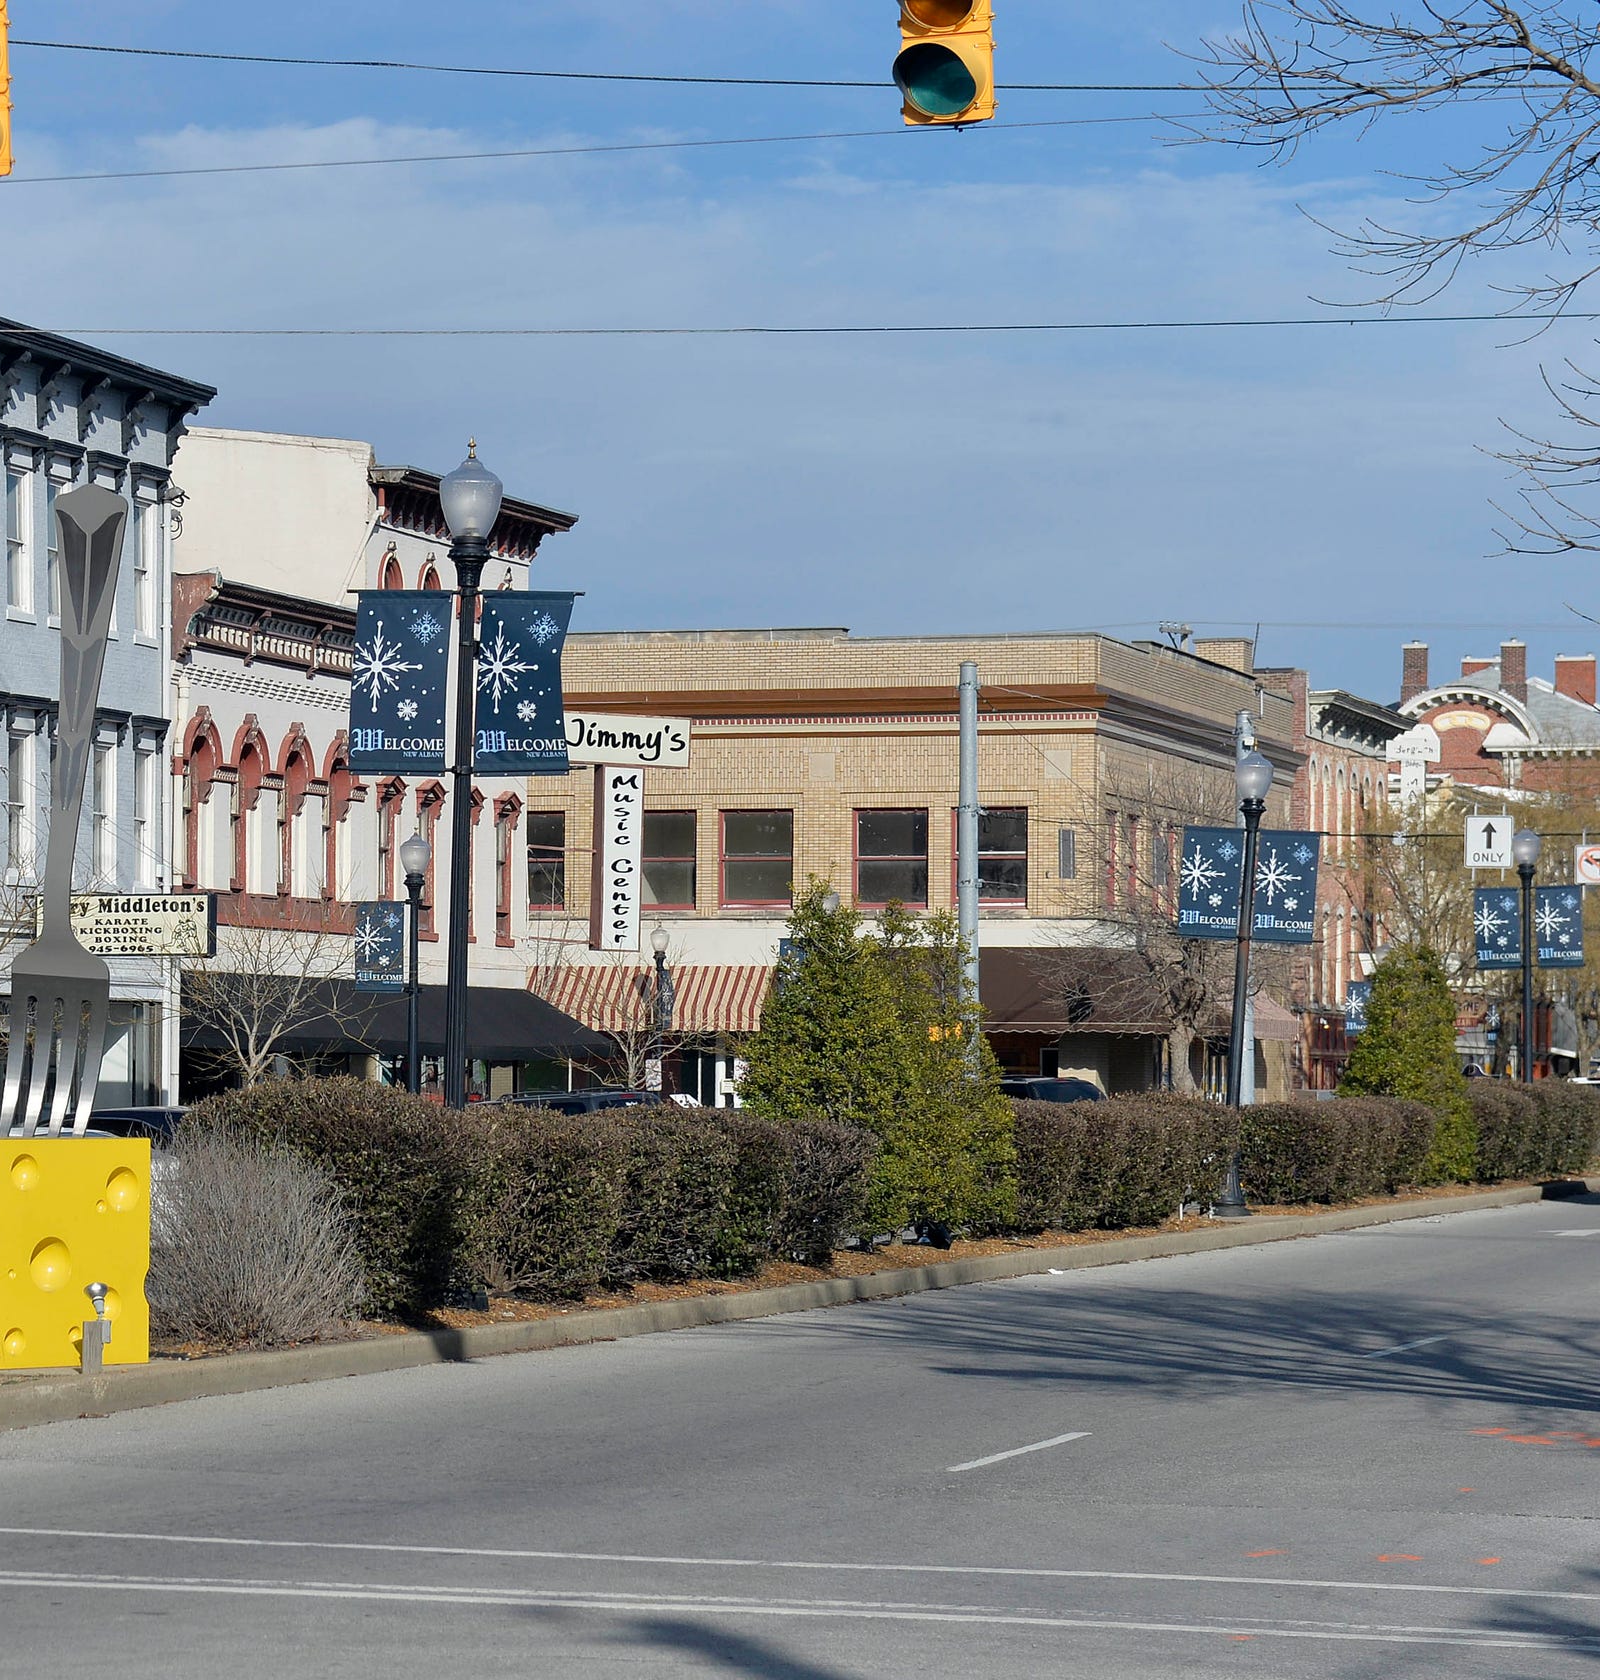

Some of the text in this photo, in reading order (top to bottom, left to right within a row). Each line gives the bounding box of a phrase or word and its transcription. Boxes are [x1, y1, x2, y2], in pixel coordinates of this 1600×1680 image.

[350, 728, 445, 758] WELCOME
[475, 729, 567, 759] WELCOME
[566, 718, 686, 762] Jimmy's
[610, 774, 639, 944] Music Center
[1472, 852, 1504, 863] ONLY
[98, 897, 205, 914] Middleton's
[94, 918, 149, 926] KARATE
[1179, 909, 1237, 928] WELCOME
[1254, 913, 1313, 932] WELCOME
[79, 927, 162, 935] KICKBOXING
[94, 936, 148, 944] BOXING
[88, 945, 154, 953] 945-6965
